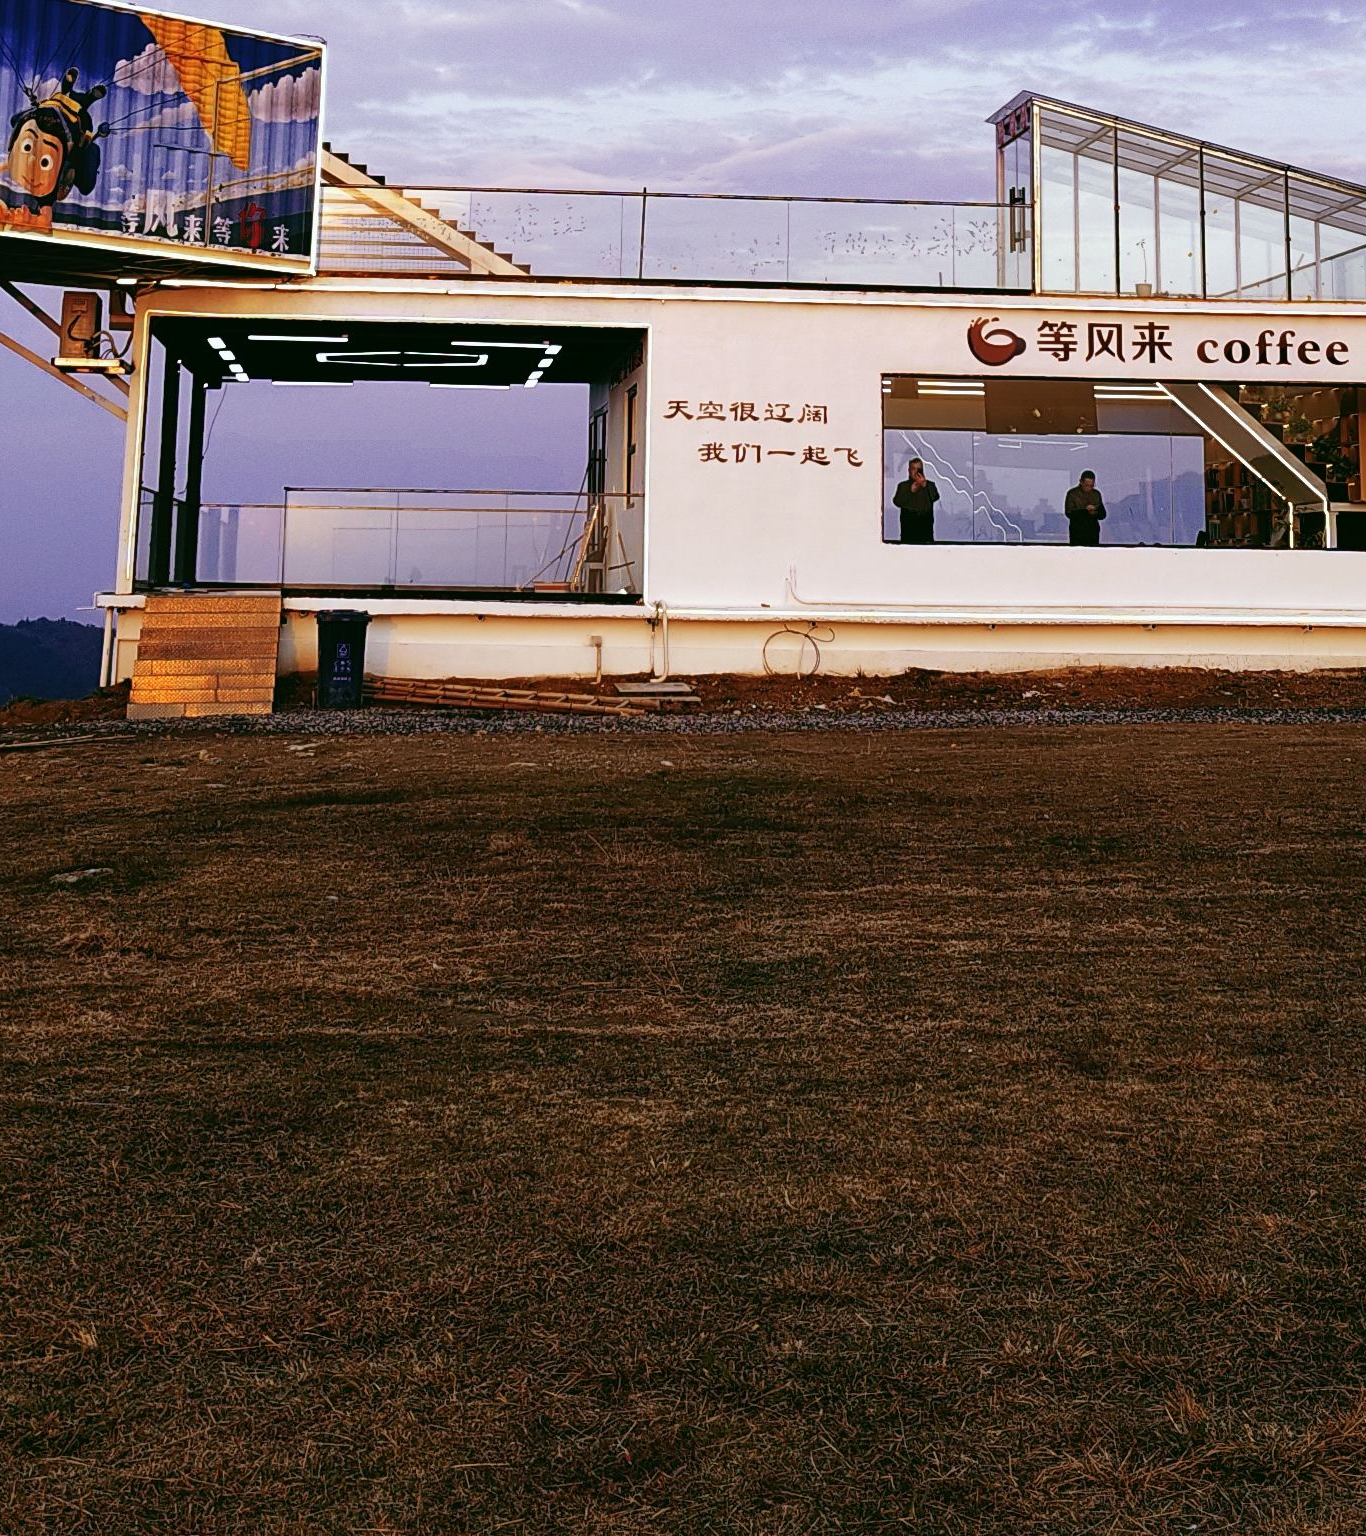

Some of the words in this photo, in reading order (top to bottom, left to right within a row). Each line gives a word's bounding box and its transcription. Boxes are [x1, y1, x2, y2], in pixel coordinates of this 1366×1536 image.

[1036, 320, 1173, 364] 等风来
[1196, 329, 1350, 366] coffee
[663, 400, 829, 425] 天空很辽阔
[697, 441, 864, 468] 我们一起飞
